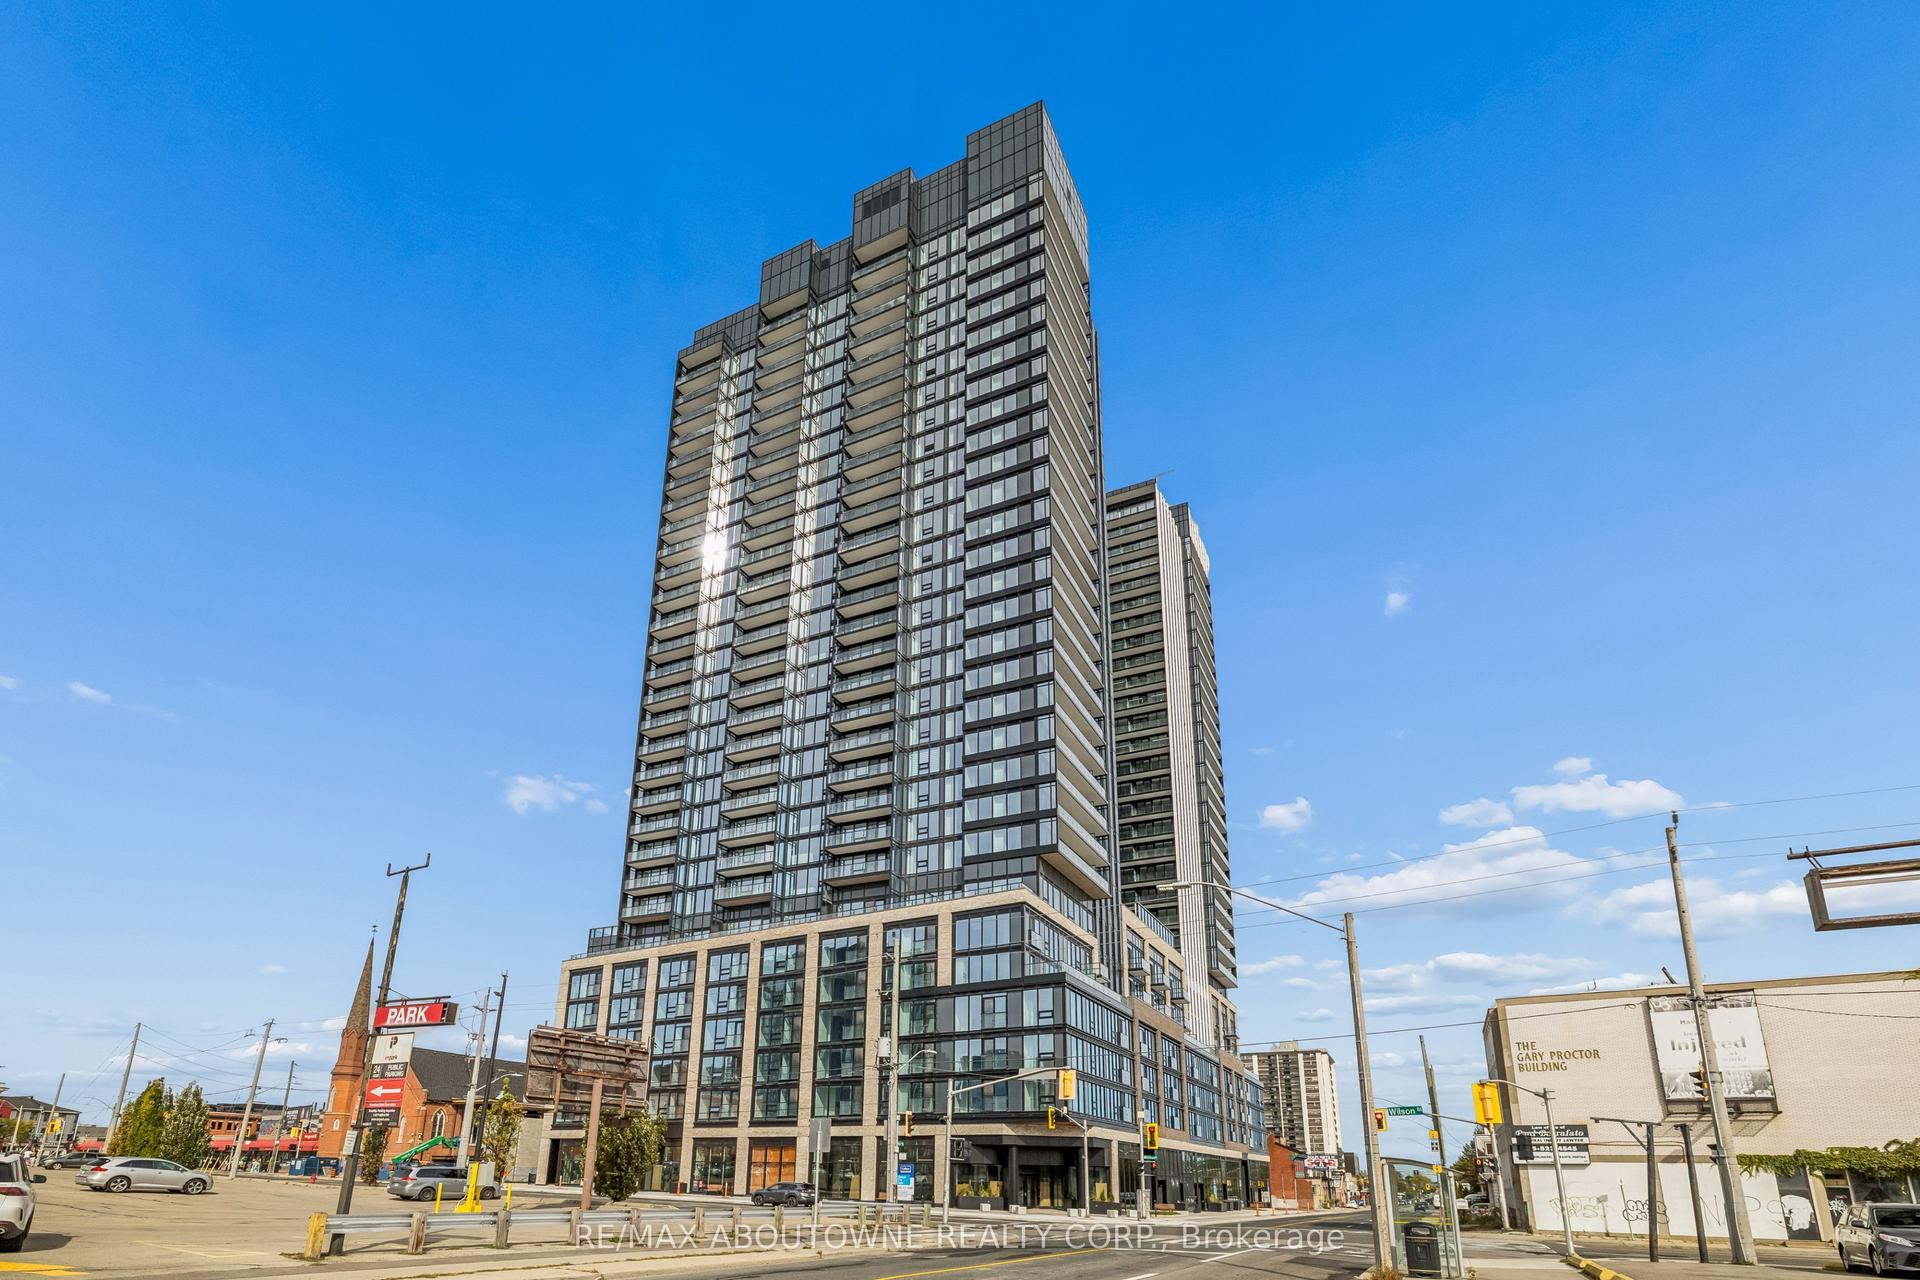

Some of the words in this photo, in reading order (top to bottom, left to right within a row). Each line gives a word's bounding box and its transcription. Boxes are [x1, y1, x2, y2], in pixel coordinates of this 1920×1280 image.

[386, 1006, 430, 1025] PARK
[1515, 1042, 1537, 1051] THE
[1517, 1052, 1545, 1062] GARY
[1549, 1049, 1600, 1061] PROCTOR
[387, 1063, 404, 1071] PUBLIC
[1518, 1062, 1567, 1072] BUILDING
